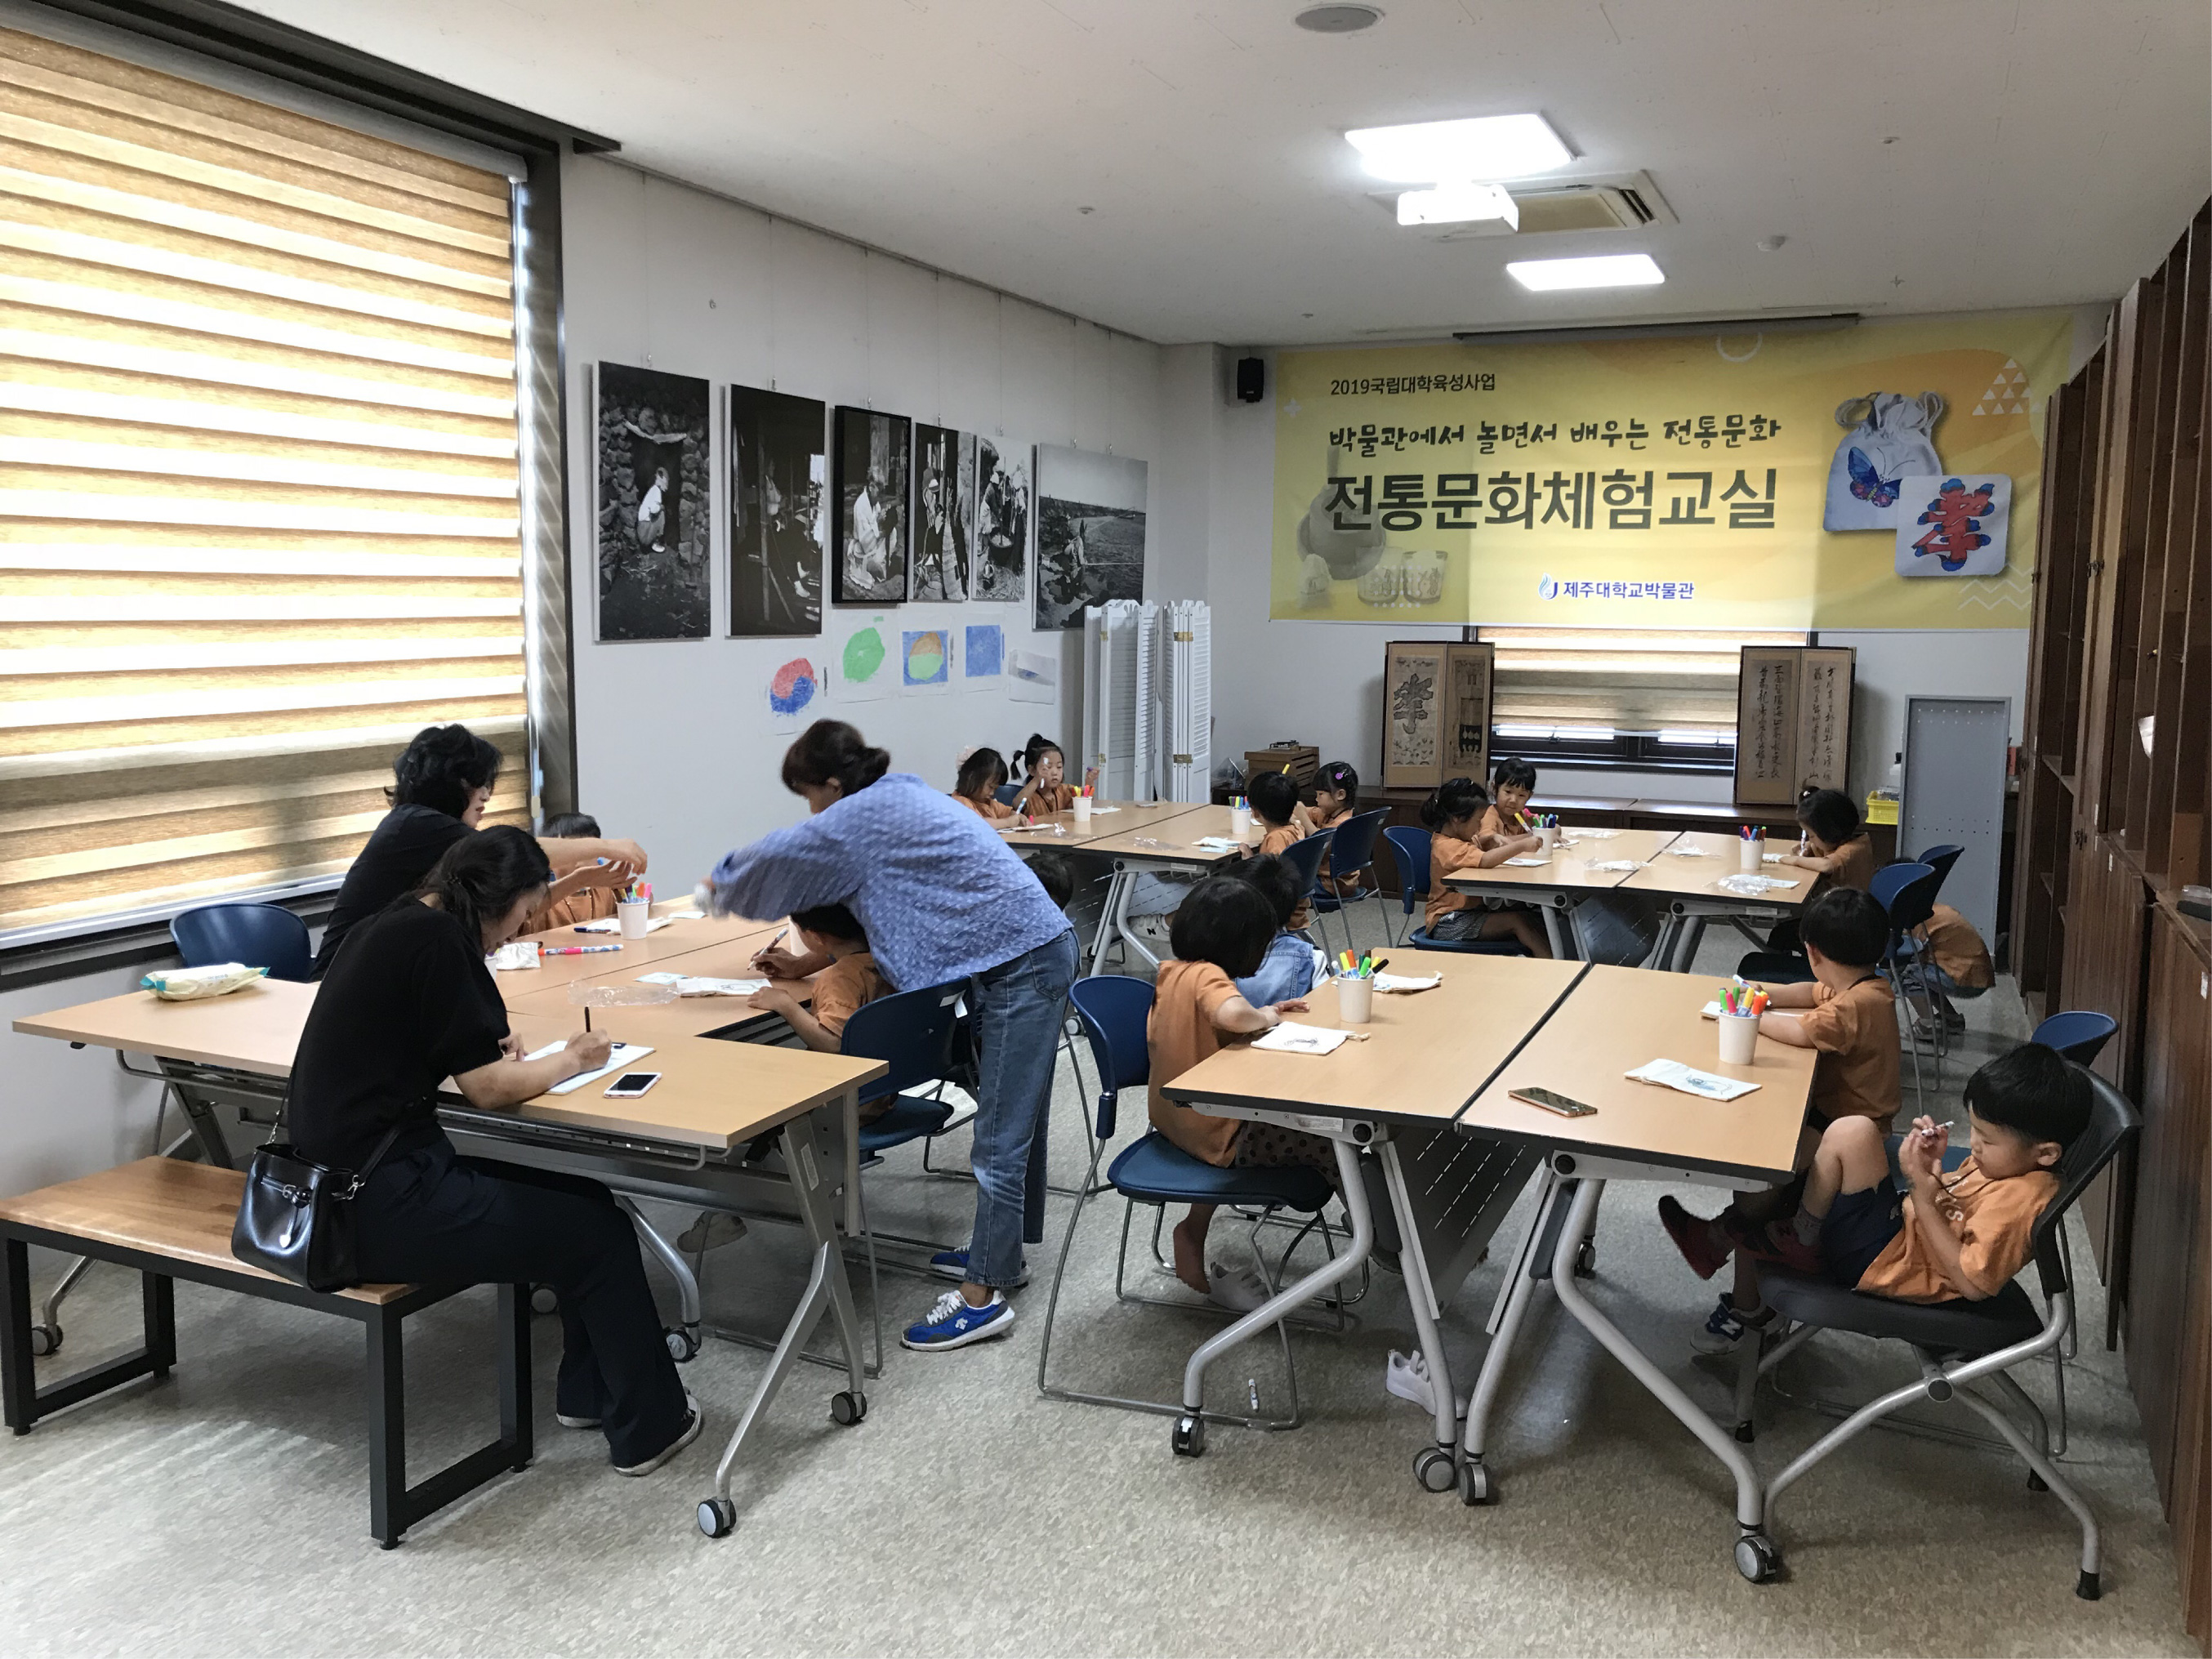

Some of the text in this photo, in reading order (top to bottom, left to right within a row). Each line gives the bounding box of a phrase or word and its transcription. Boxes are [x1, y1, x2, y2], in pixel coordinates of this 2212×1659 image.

[1331, 374, 1496, 395] 2019국립대학육성사업
[1330, 414, 1782, 457] 박물관에서 놀면서 배우는 전통문화
[1325, 468, 1777, 531] 전통문화체험교실
[1563, 582, 1694, 600] 제주대학교박물관
